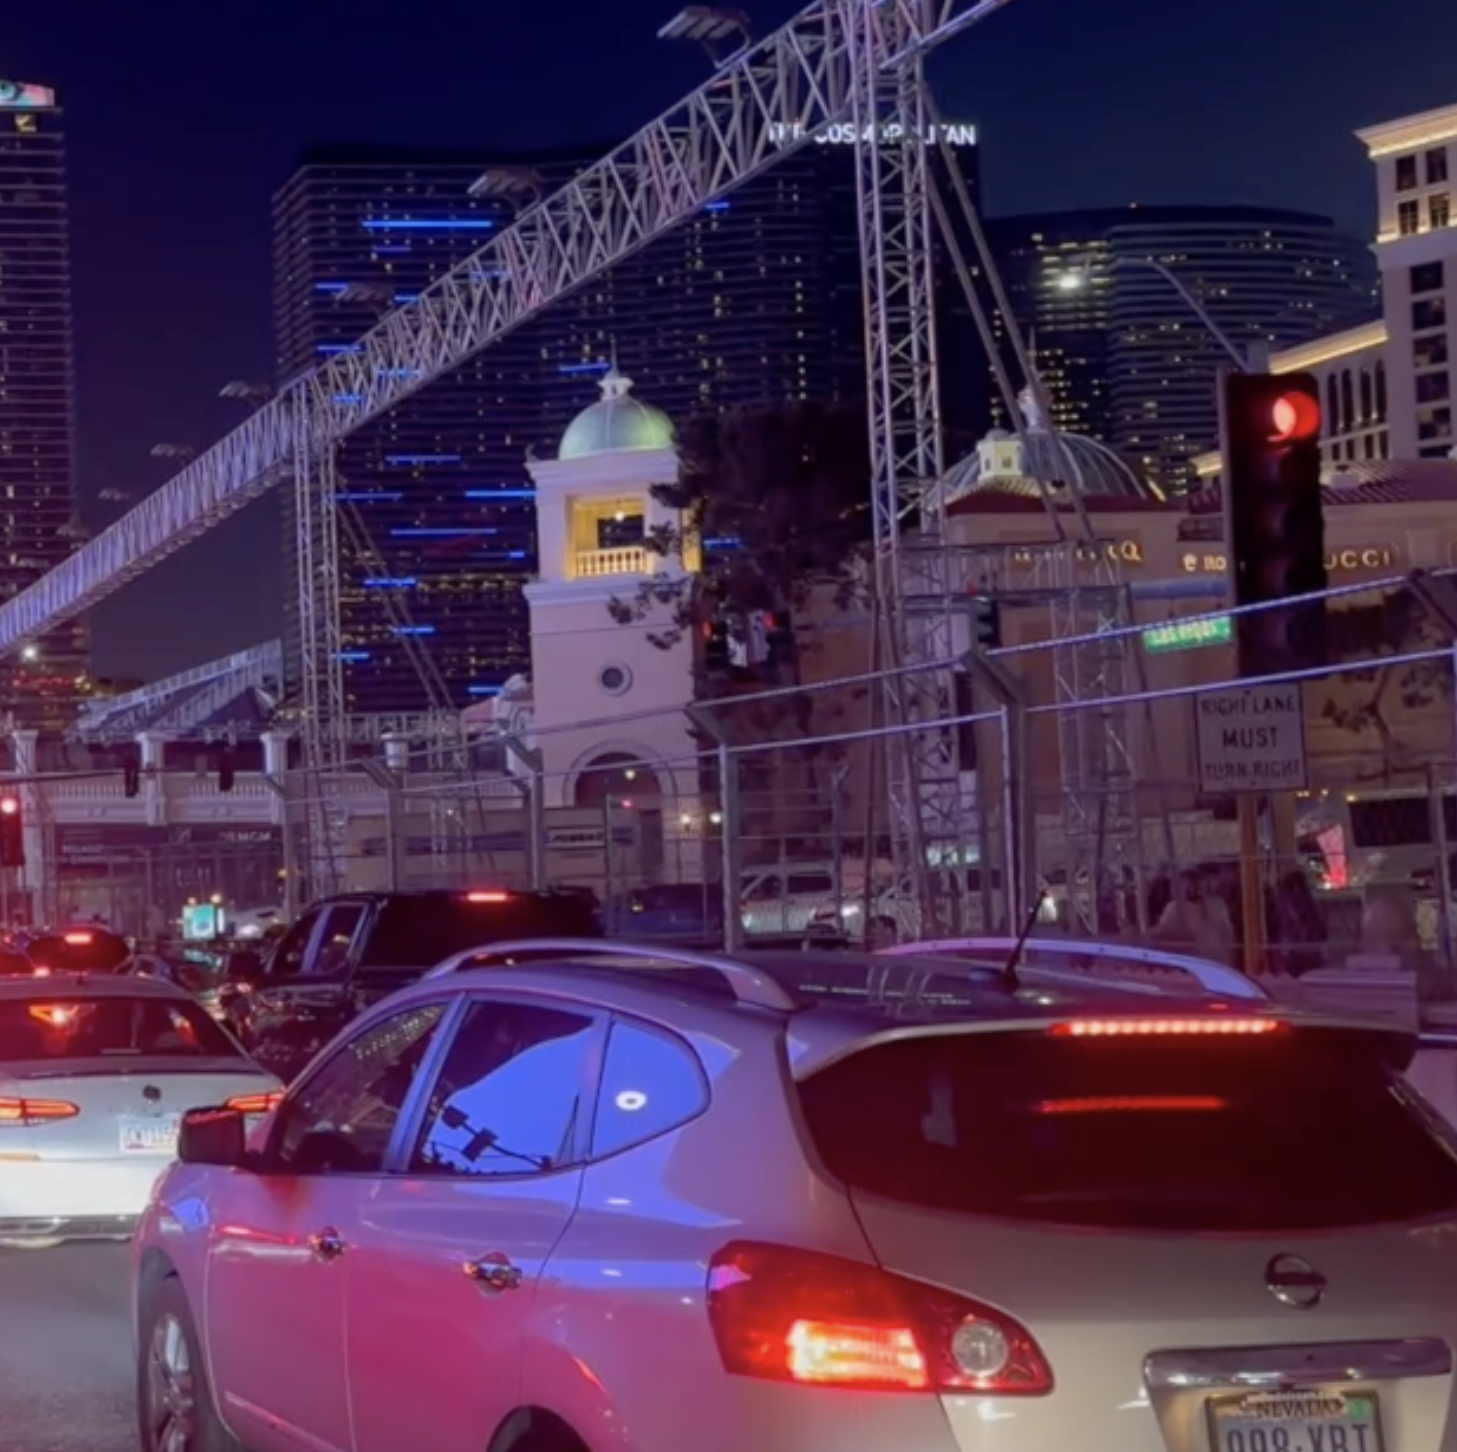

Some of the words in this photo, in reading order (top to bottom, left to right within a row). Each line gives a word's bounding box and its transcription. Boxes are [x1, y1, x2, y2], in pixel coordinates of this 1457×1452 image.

[1324, 549, 1390, 570] UCCI
[1201, 697, 1247, 716] RIGHT
[1253, 695, 1296, 714] LANE
[1222, 725, 1278, 749] MUST
[1205, 762, 1246, 780] TURN
[1252, 759, 1300, 778] RIGHT
